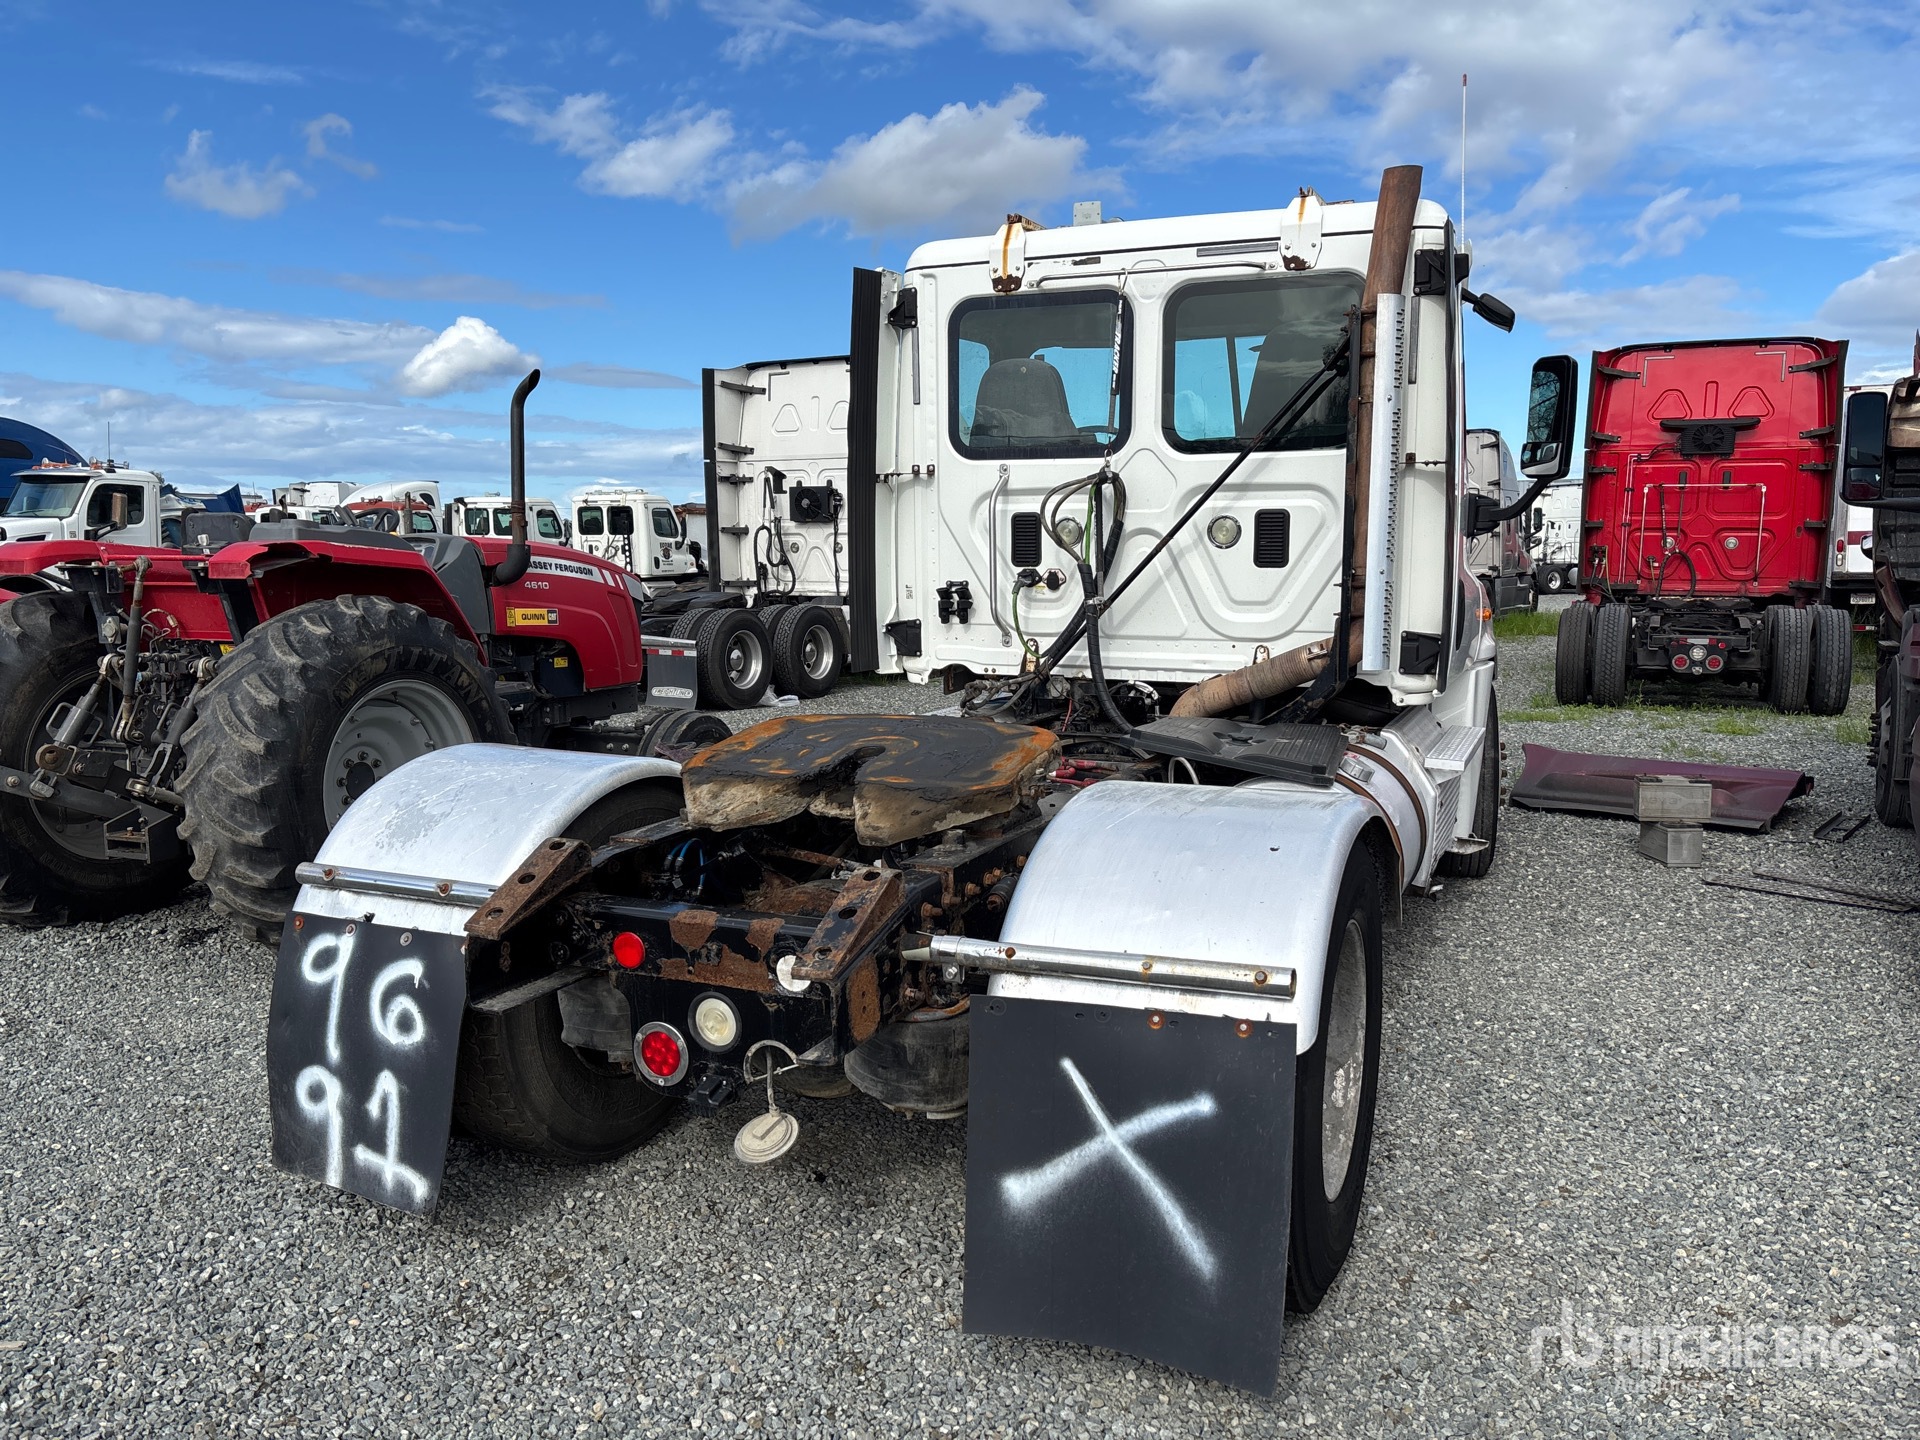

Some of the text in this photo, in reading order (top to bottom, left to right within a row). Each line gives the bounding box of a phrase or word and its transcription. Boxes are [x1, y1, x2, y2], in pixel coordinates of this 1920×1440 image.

[528, 560, 594, 576] ASSEY FERGUSON
[524, 581, 550, 589] 4610
[521, 612, 557, 621] QUINN CAT
[384, 645, 486, 705] TITAN
[652, 687, 692, 698] FREIGHTLINER
